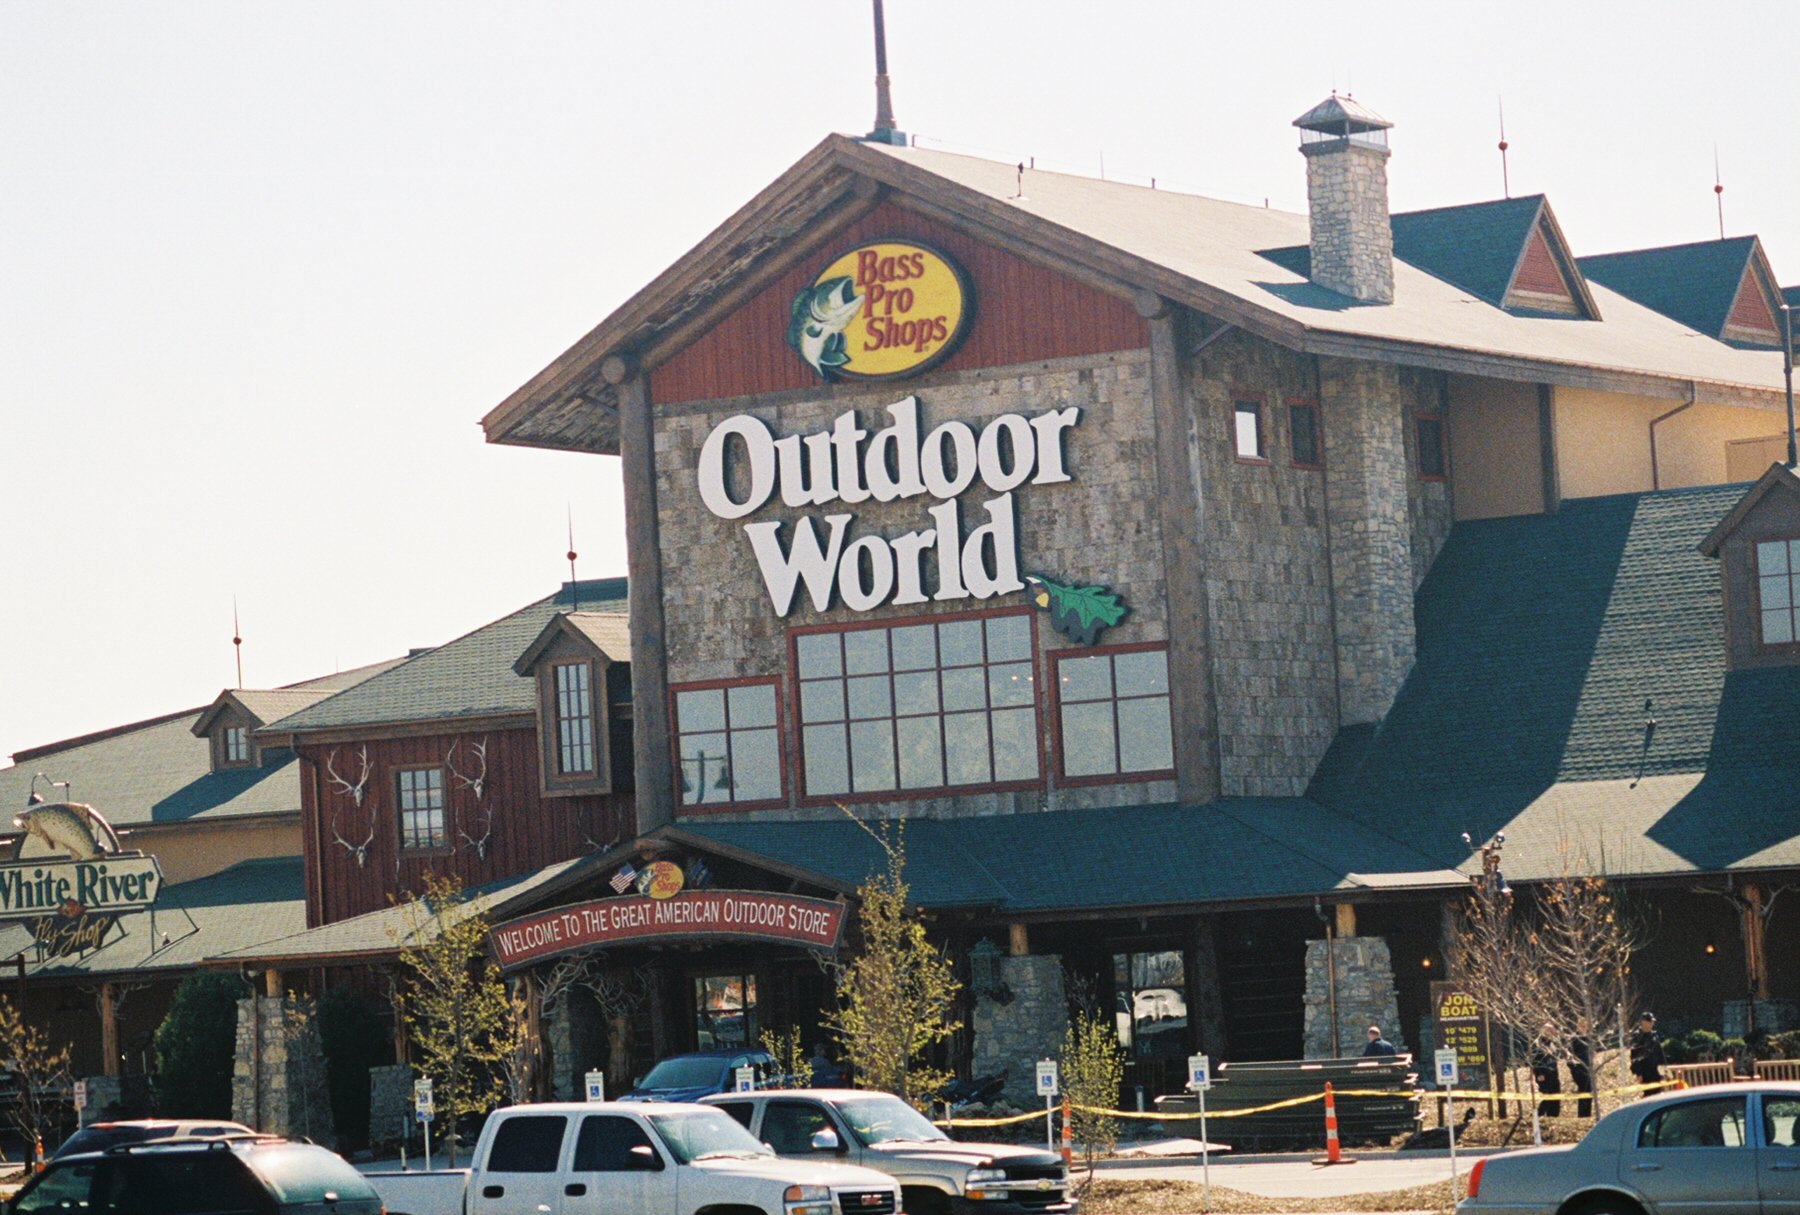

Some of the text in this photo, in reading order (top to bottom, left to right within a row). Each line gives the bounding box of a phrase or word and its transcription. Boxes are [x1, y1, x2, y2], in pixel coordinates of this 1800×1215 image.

[856, 250, 925, 286] Bass
[863, 284, 914, 319] Pro
[863, 315, 948, 353] Shops
[698, 395, 1080, 519] Outdoor
[743, 490, 1026, 618] World
[76, 865, 154, 907] River
[57, 913, 110, 957] Shop
[498, 898, 831, 957] WELCOME TO THE GREAT AMERICAN OUTDOOR STORE
[1441, 1005, 1477, 1016] BOAT
